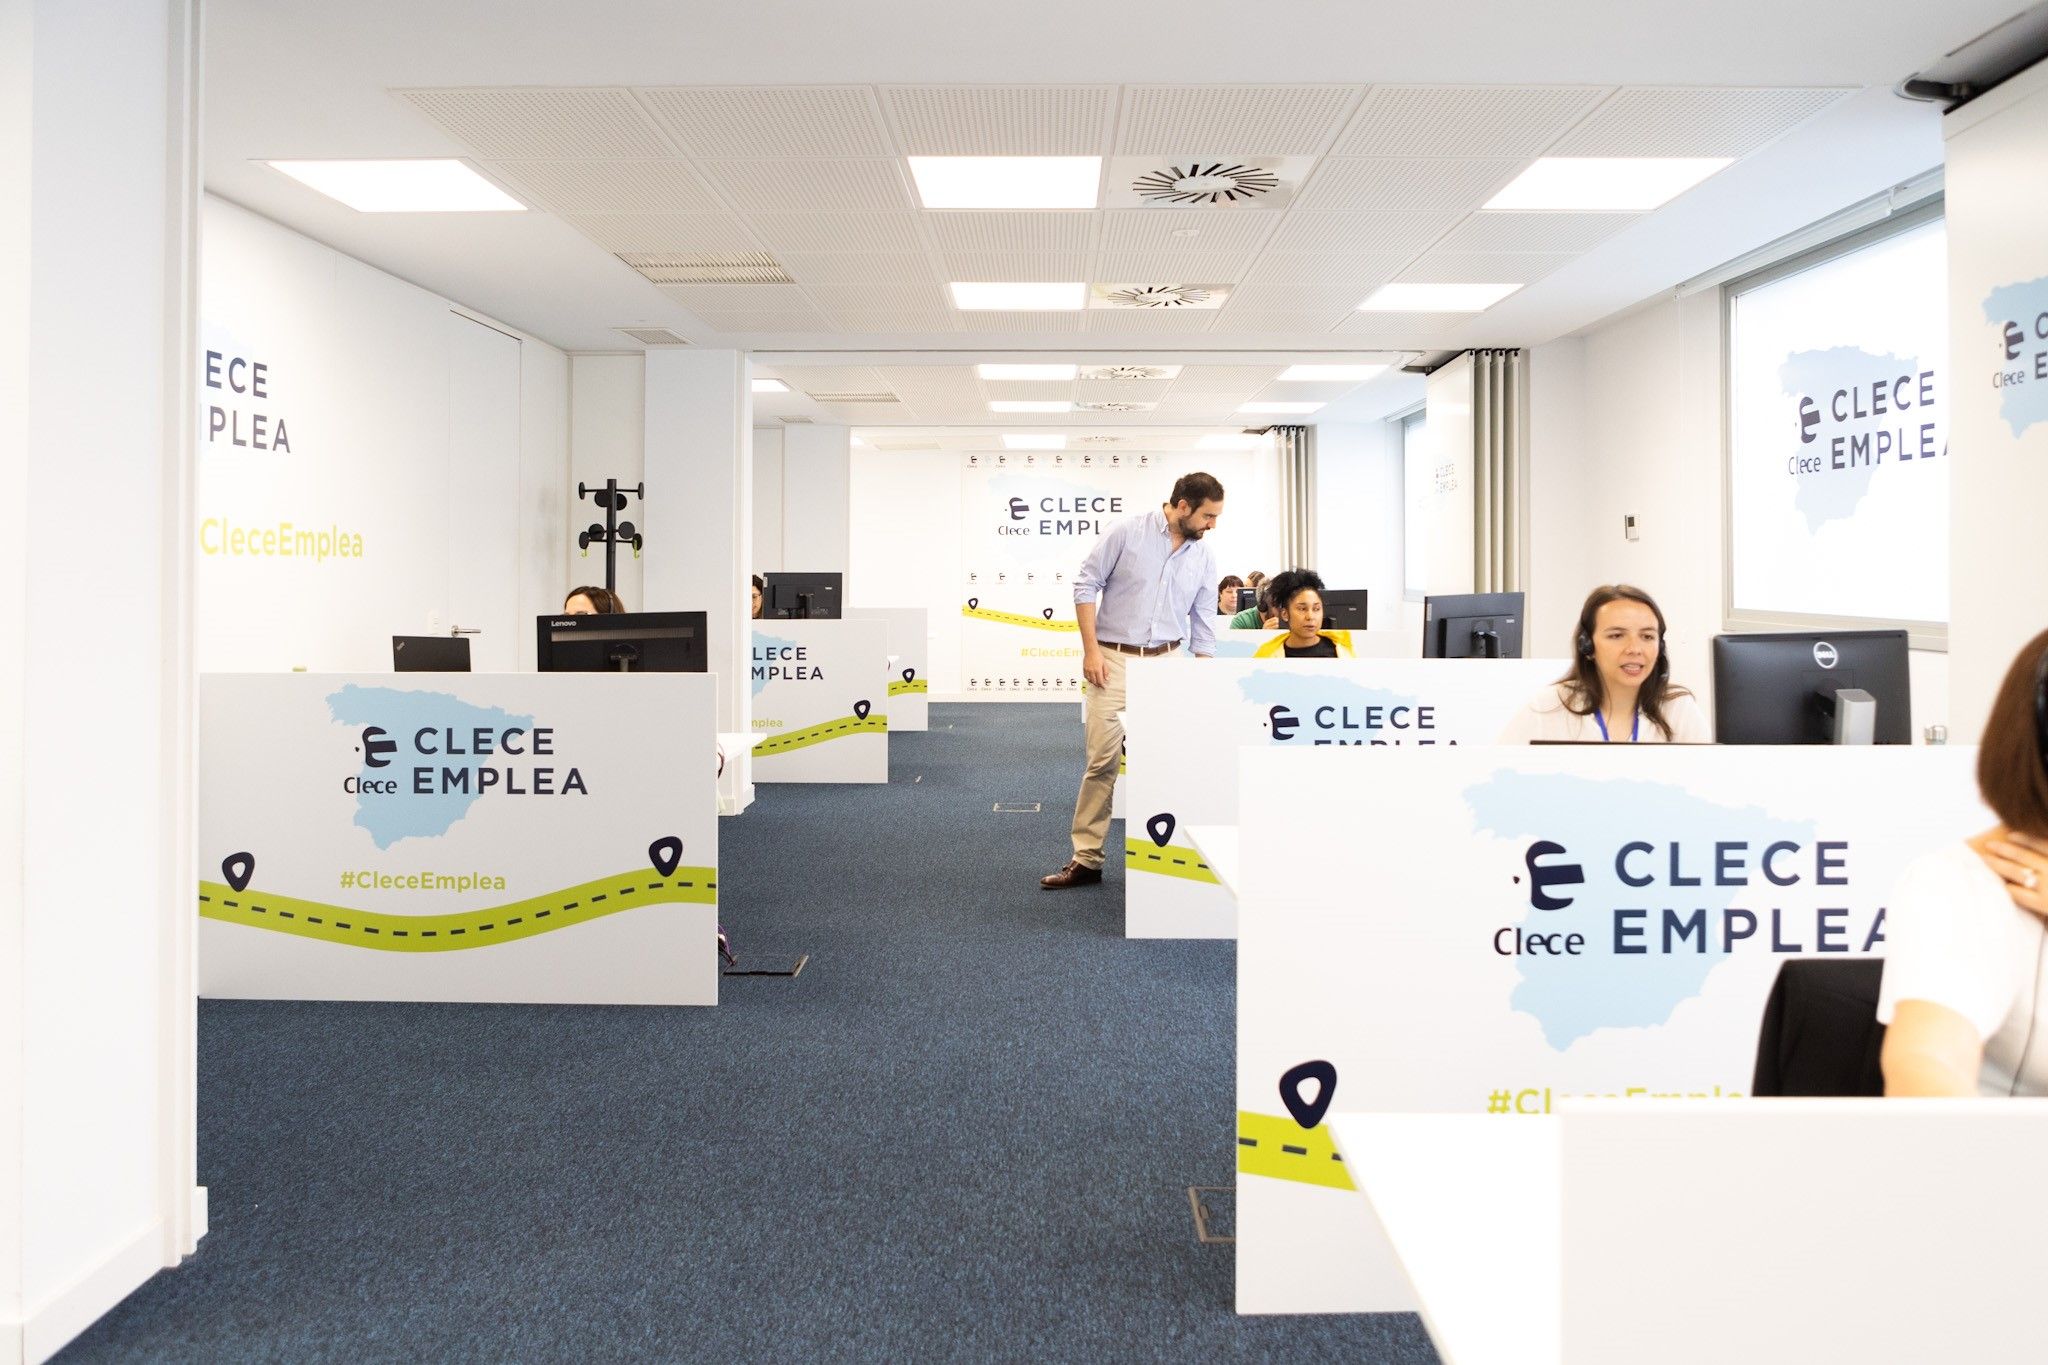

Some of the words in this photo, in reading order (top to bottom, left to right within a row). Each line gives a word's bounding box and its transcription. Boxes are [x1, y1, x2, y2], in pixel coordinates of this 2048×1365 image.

[206, 349, 268, 399] ECE
[1992, 370, 2025, 389] Clece
[1831, 370, 1935, 424] CLECE
[1788, 456, 1822, 476] Clece
[1040, 497, 1123, 513] CLECE
[200, 517, 364, 563] CleceEmplea
[998, 525, 1030, 536] Clece
[752, 646, 807, 661] LECE
[1314, 705, 1436, 730] CLECE
[414, 727, 554, 756] CLECE
[343, 776, 398, 795] Clece
[413, 766, 589, 795] EMPLEA
[1614, 840, 1850, 888] CLECE
[340, 871, 507, 893] #CleceEmplea
[1493, 927, 1585, 956] Clece
